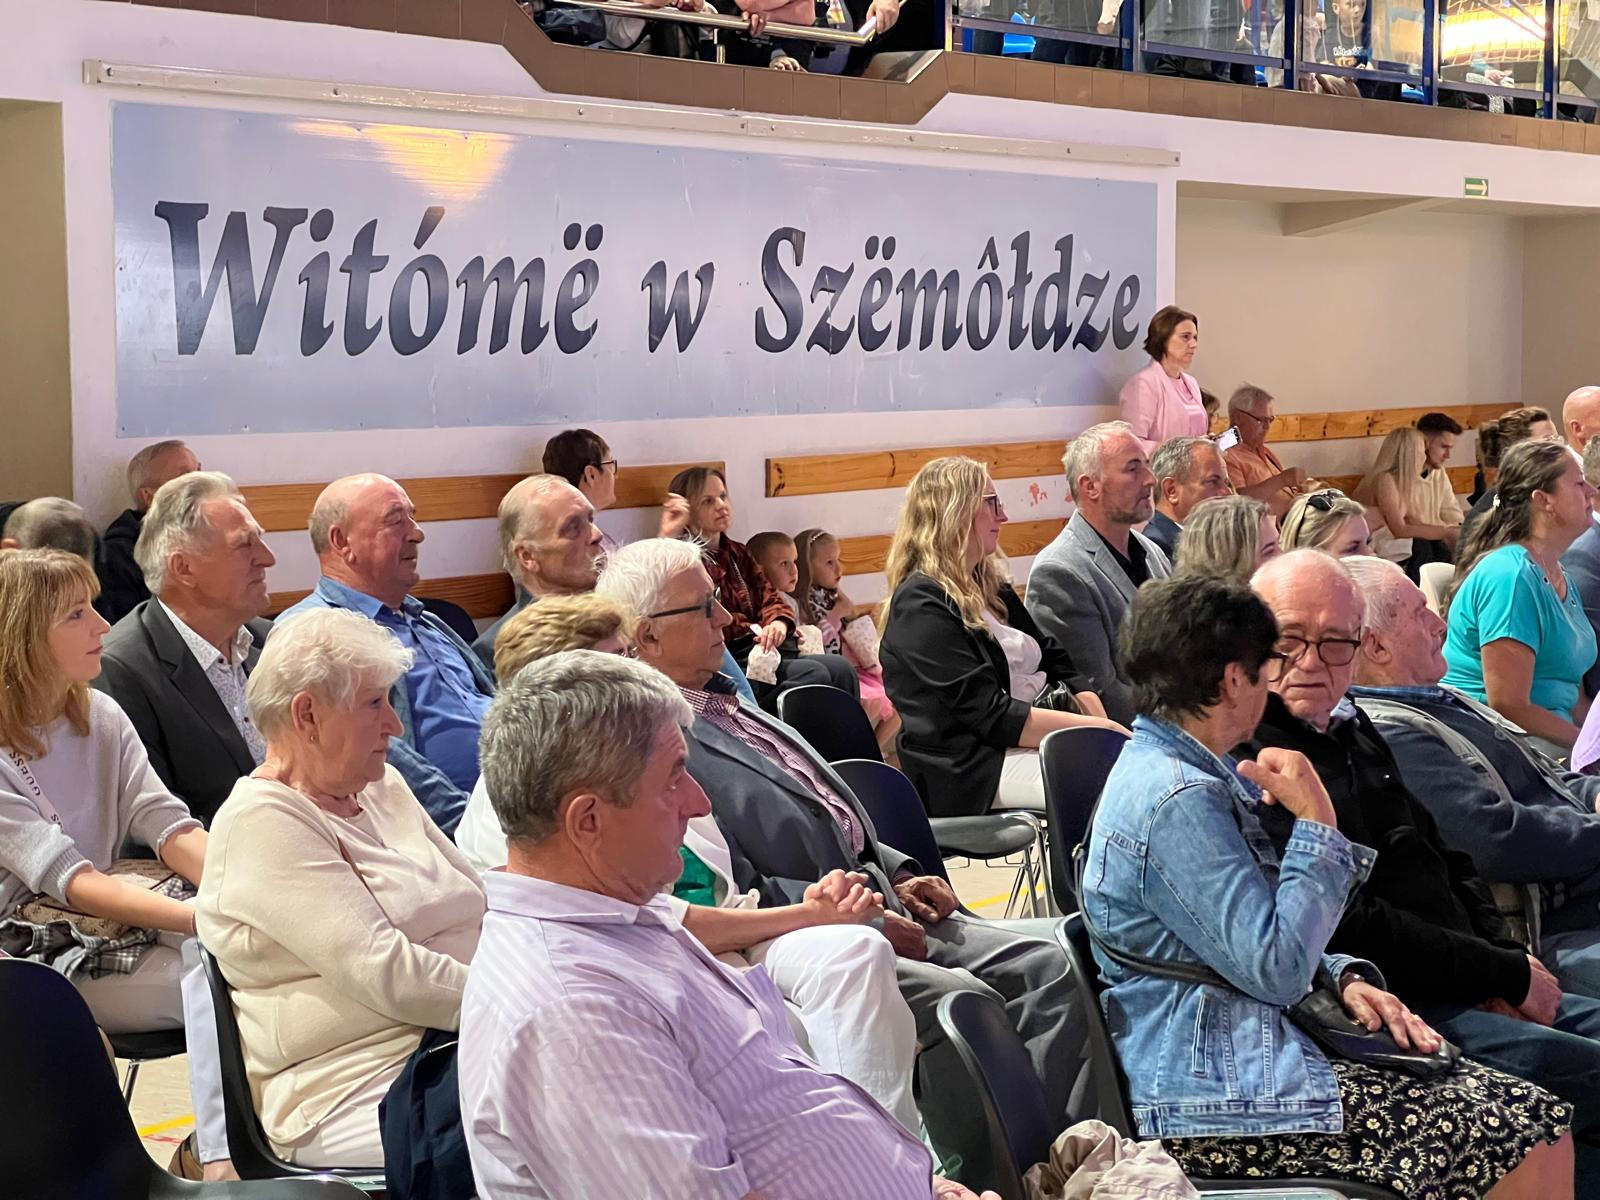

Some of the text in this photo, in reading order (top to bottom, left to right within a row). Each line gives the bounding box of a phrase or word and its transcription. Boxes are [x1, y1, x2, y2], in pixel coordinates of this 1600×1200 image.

[154, 200, 1141, 356] Witómë w Szëmôłdze
[9, 751, 41, 797] GUESS
